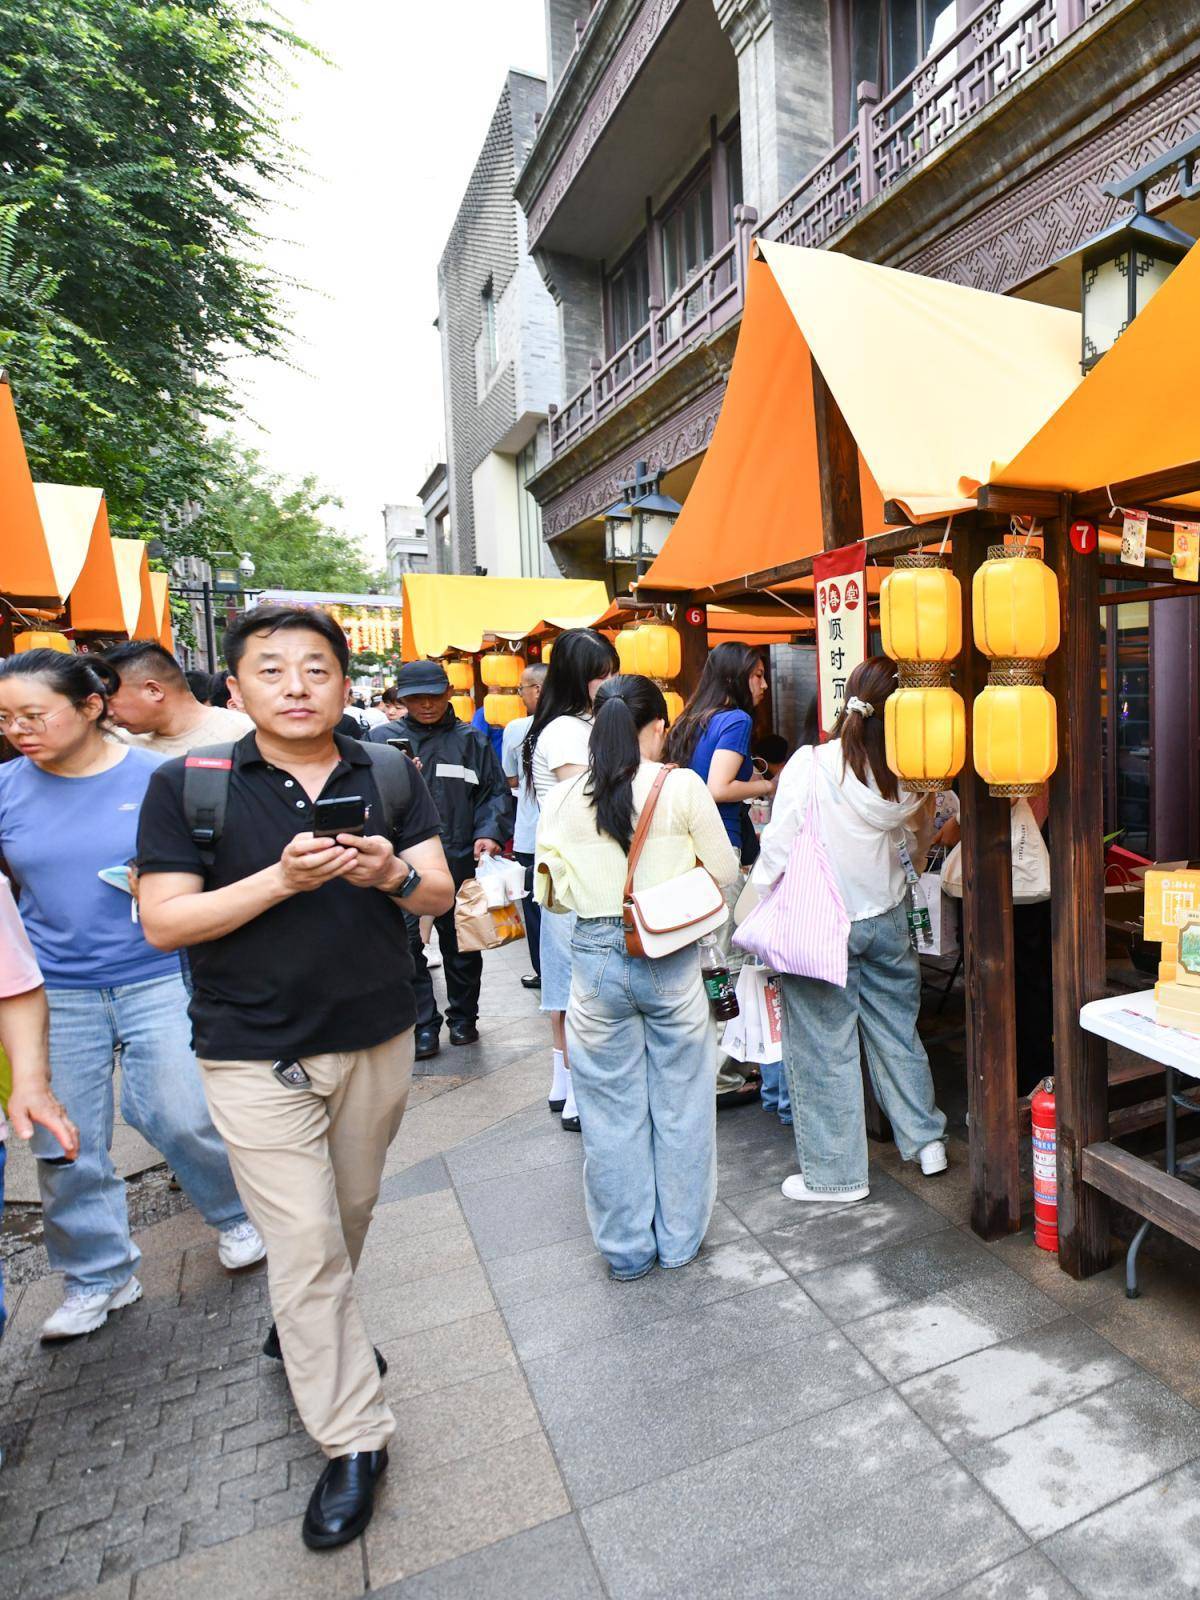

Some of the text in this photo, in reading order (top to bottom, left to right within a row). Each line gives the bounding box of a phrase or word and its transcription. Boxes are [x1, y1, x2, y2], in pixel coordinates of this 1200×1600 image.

[1076, 525, 1089, 549] 7
[691, 610, 700, 623] 6
[828, 618, 847, 716] 顺时而
